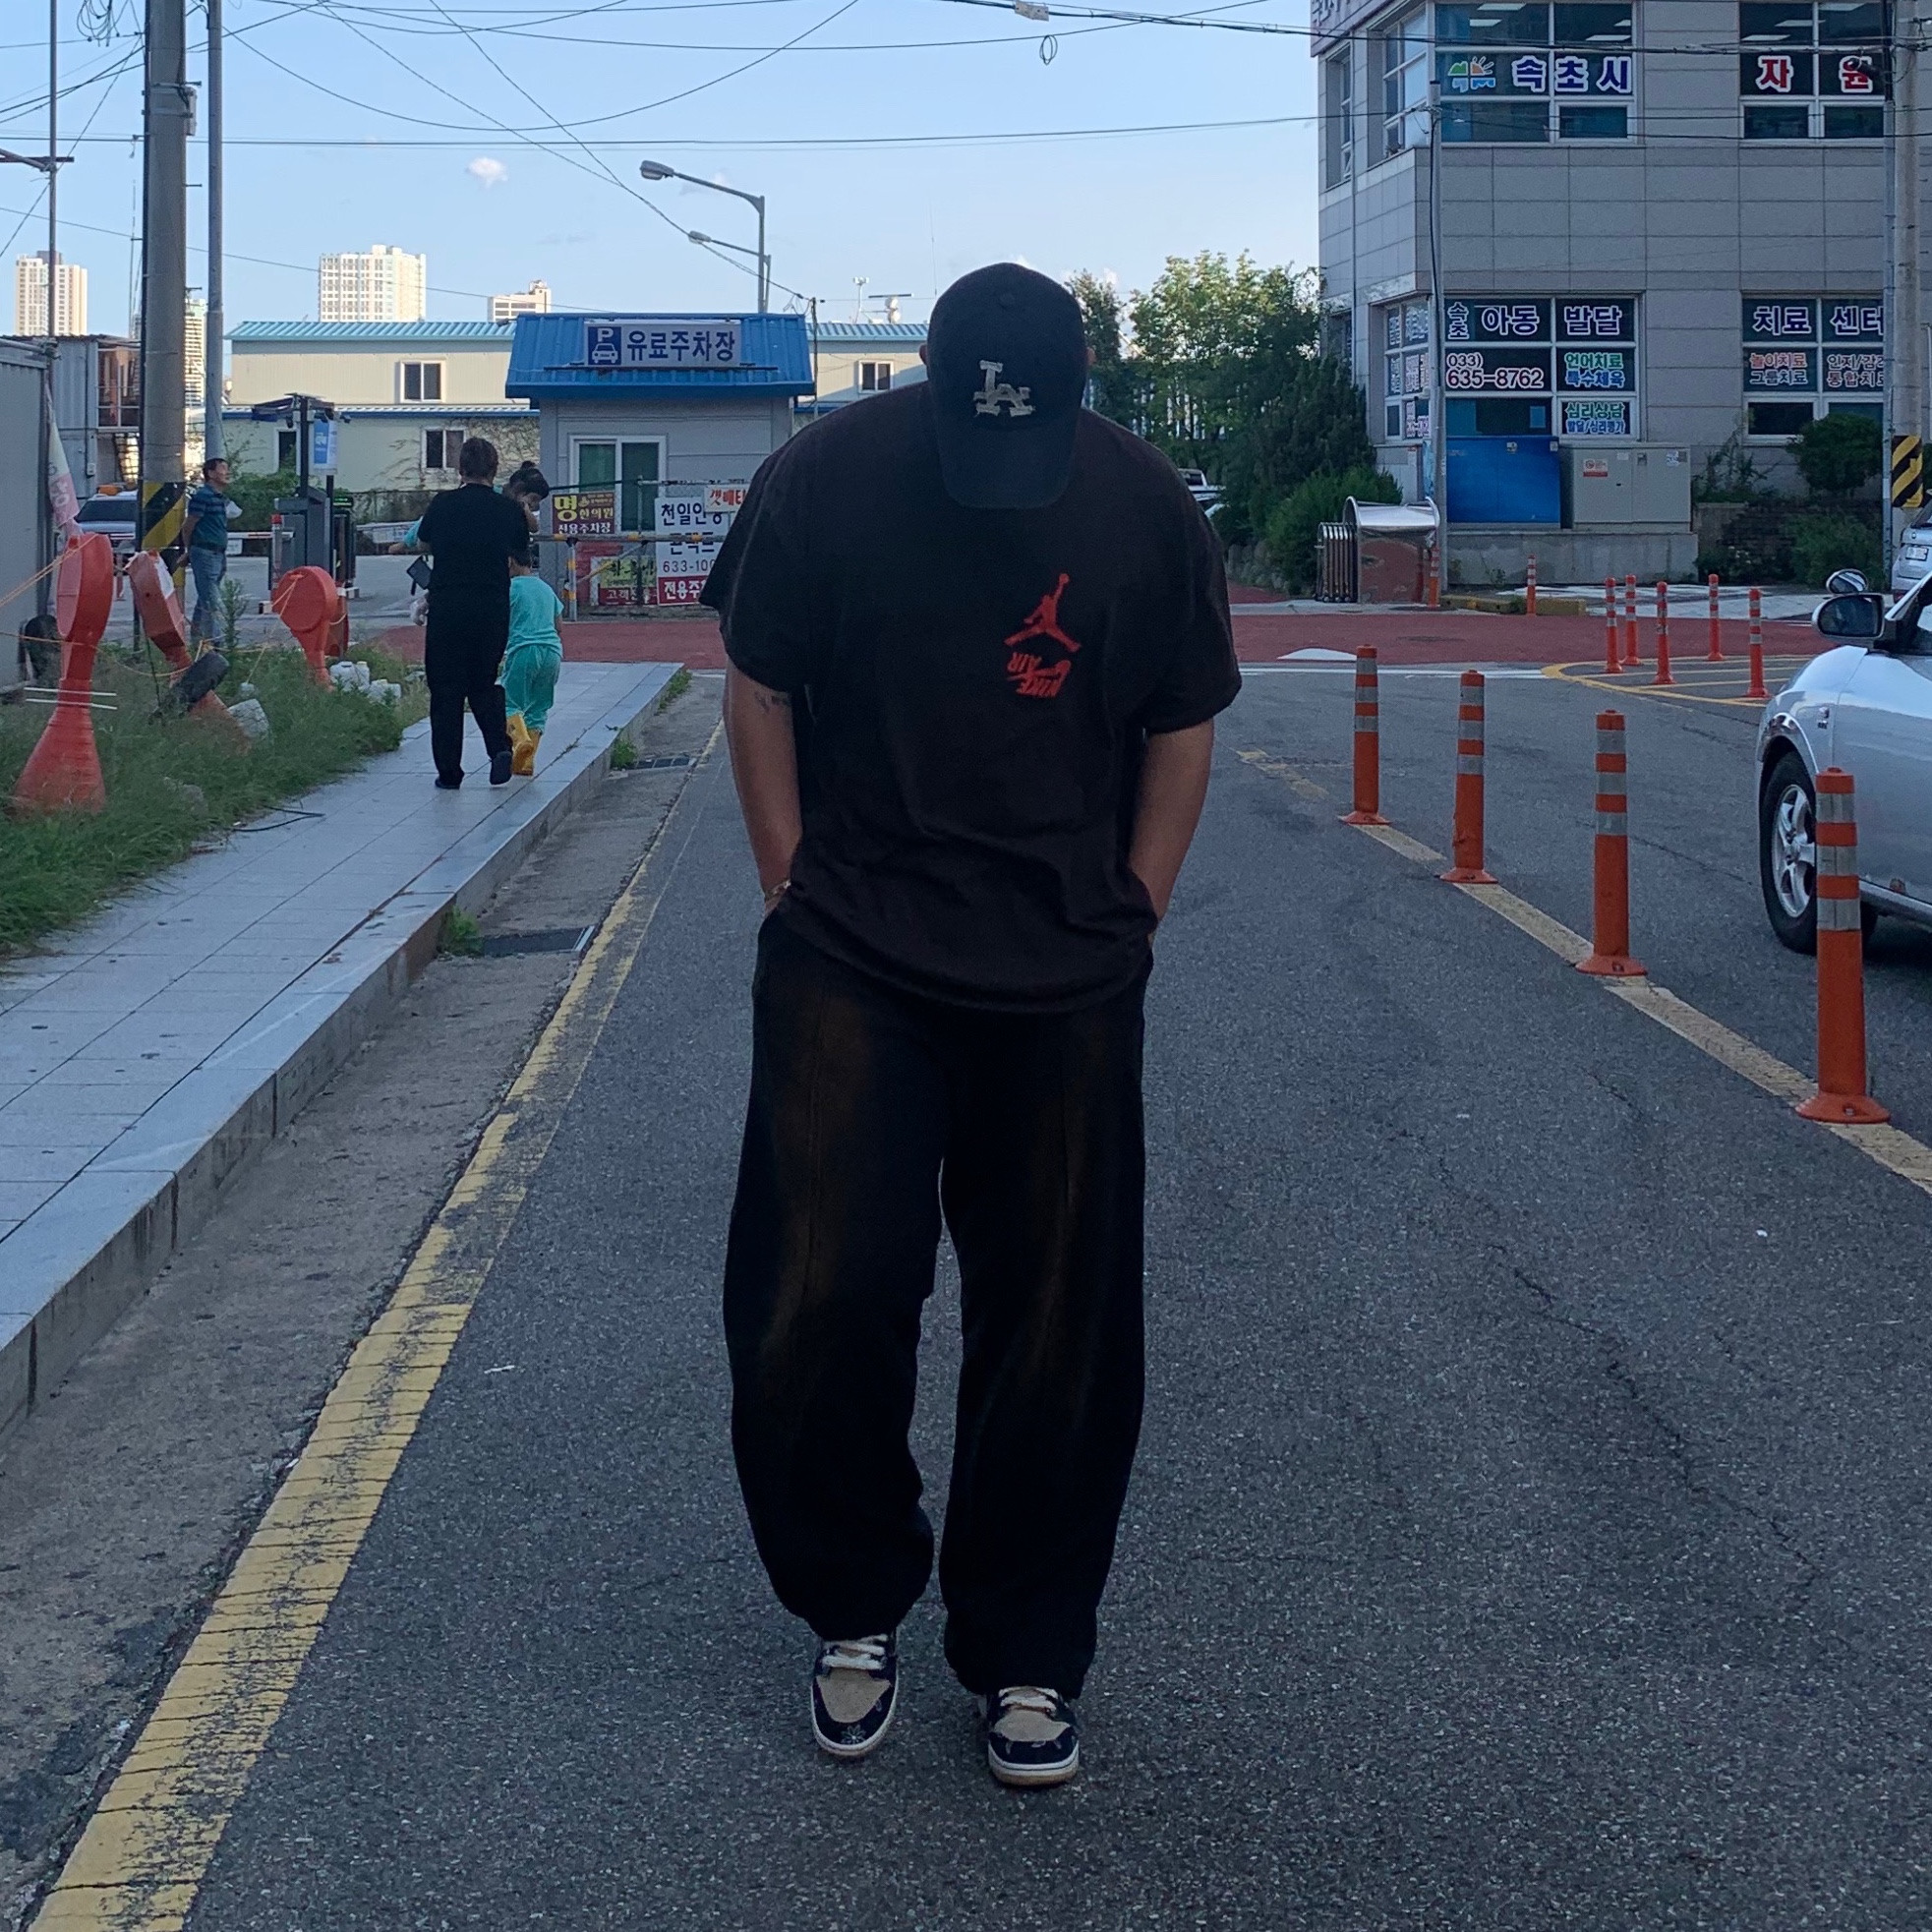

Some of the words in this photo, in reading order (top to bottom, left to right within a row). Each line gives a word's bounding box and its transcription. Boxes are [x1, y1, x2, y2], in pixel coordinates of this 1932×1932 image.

[1511, 55, 1632, 92] 속초시
[1447, 302, 1469, 340] 속초
[1482, 305, 1540, 335] 아동
[1564, 305, 1622, 335] 발달
[1752, 306, 1811, 335] 치료
[1830, 306, 1884, 335] 센터
[598, 328, 614, 342] P
[627, 330, 735, 362] 유료주차장
[1446, 352, 1483, 369] 033)
[1564, 352, 1623, 370] 언어치료
[1750, 352, 1807, 369] 놀이치료
[1446, 368, 1544, 388] 635-8762
[973, 360, 1035, 417] LA
[1564, 401, 1625, 419] 심리상담
[555, 495, 577, 521] 명
[664, 580, 706, 600] 전용주
